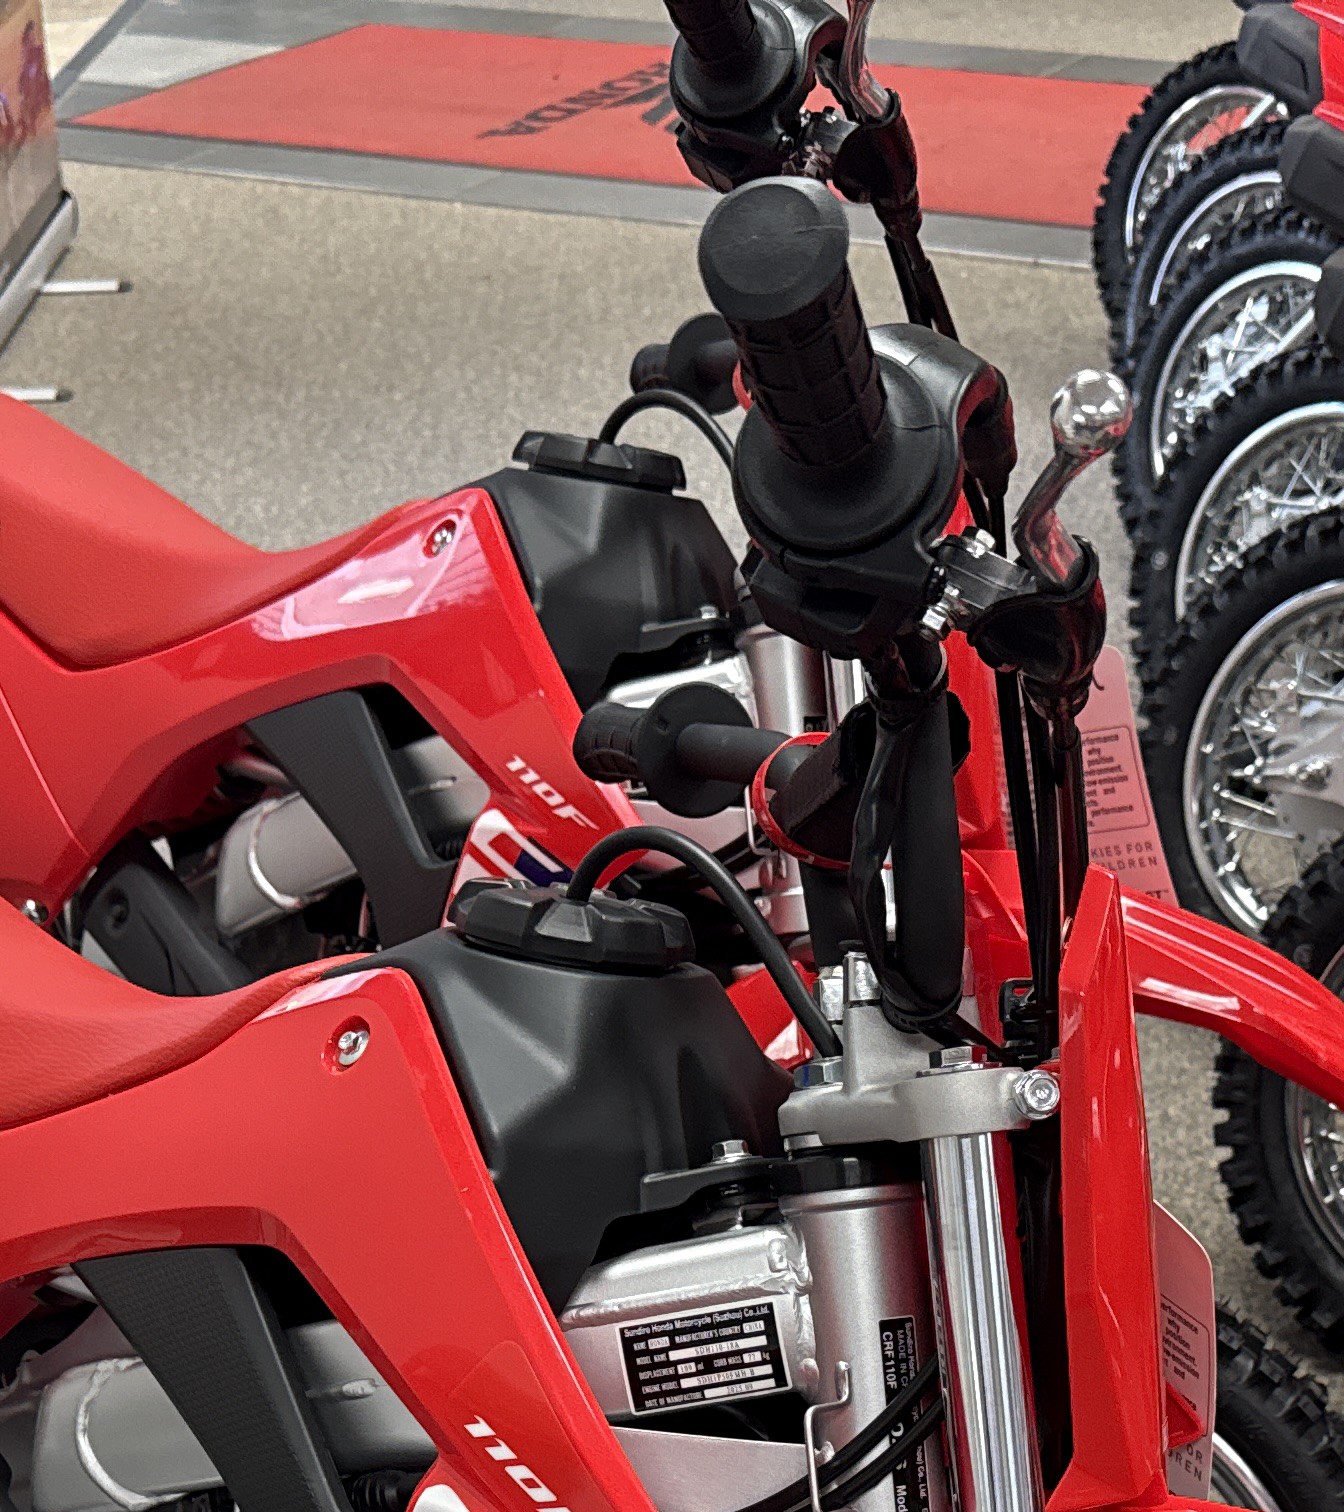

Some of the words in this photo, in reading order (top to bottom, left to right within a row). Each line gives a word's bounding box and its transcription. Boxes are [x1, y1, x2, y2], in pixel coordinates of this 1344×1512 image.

[506, 754, 600, 831] 110F
[1090, 845, 1122, 858] KIES
[1126, 841, 1153, 854] FOR
[1102, 856, 1157, 871] LDREN
[895, 1328, 906, 1359] MADE
[881, 1330, 898, 1390] CRF110F
[898, 1361, 908, 1373] IN
[1186, 1443, 1203, 1464] OR
